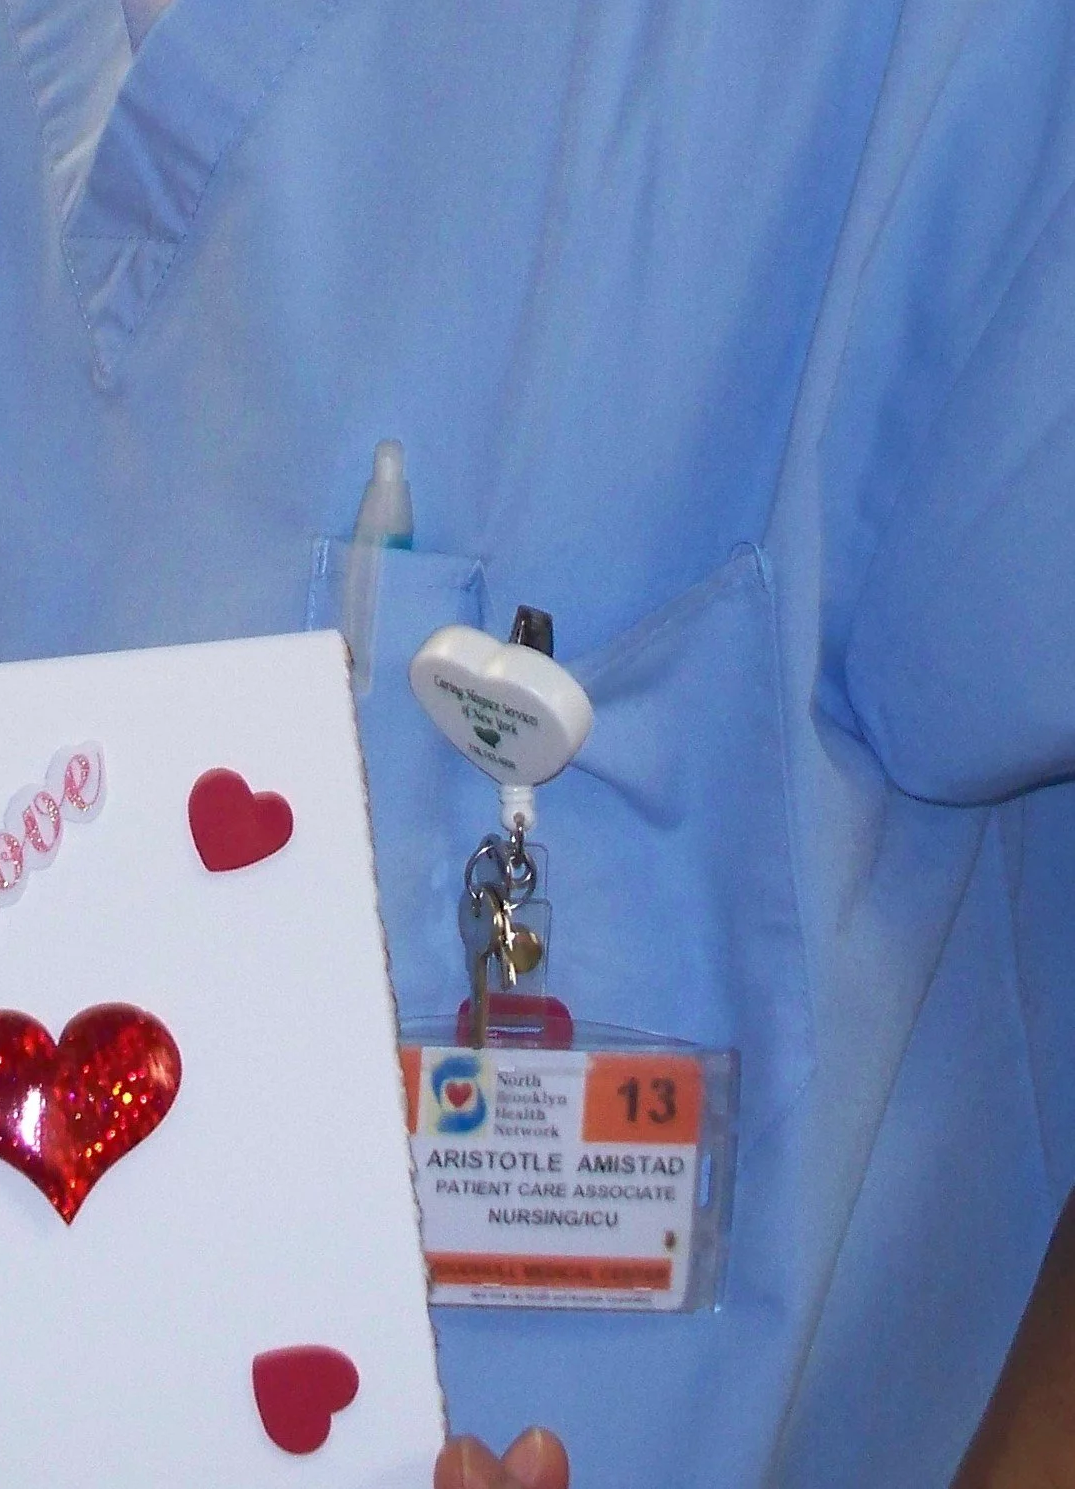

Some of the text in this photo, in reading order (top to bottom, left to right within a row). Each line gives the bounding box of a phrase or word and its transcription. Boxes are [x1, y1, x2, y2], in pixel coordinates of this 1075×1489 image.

[496, 1072, 541, 1088] North
[616, 1076, 678, 1125] 13
[492, 1124, 560, 1139] Network
[426, 1148, 686, 1177] ARISTOTLE AMISTAD
[435, 1178, 677, 1202] PATIENT CARE ASSOCIATE
[487, 1207, 620, 1229] NURSING/ICU
